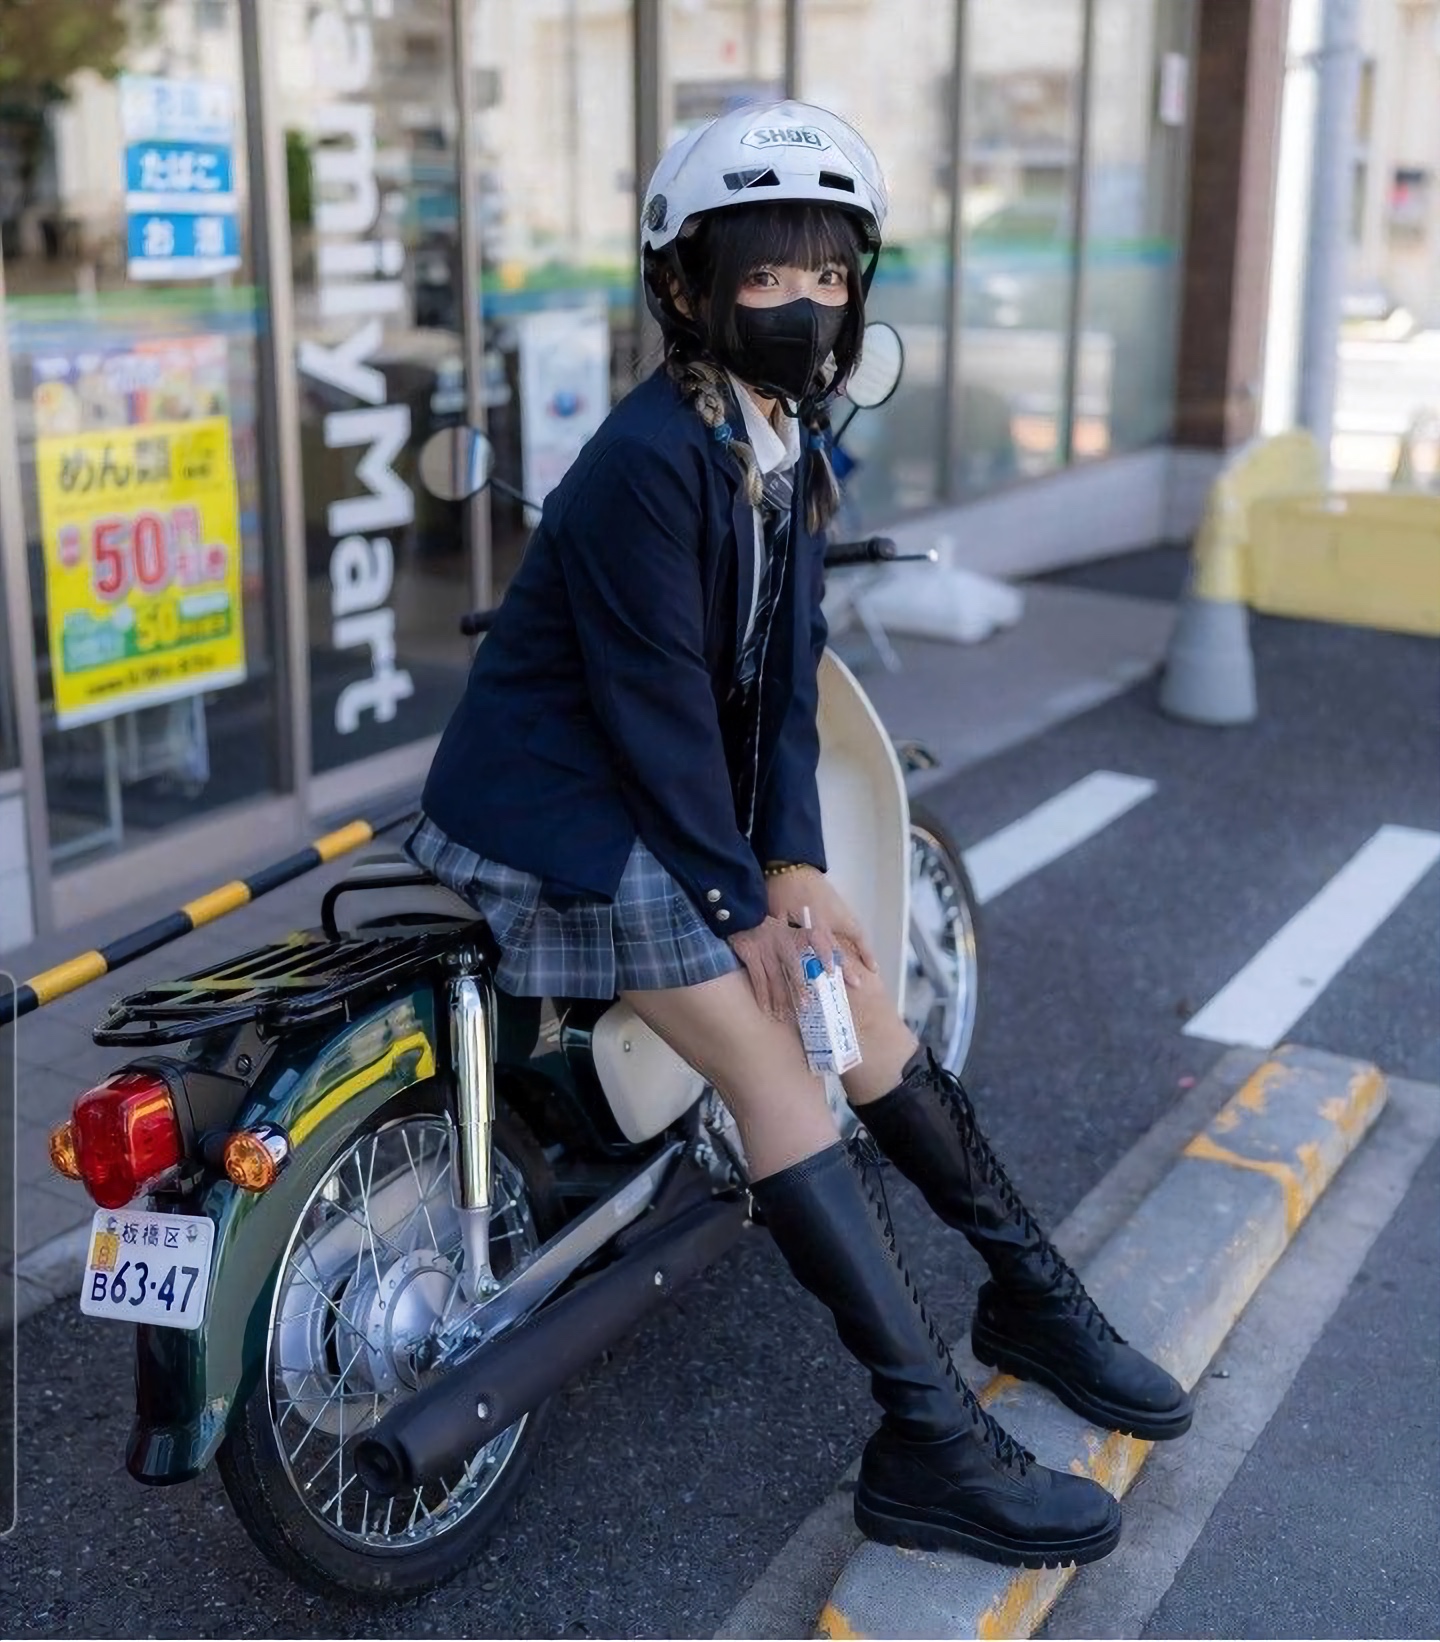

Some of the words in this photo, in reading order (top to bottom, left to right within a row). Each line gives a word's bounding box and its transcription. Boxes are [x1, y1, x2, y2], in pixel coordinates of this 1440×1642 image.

[301, 0, 415, 734] amilyMart
[121, 1221, 181, 1249] 板橋区
